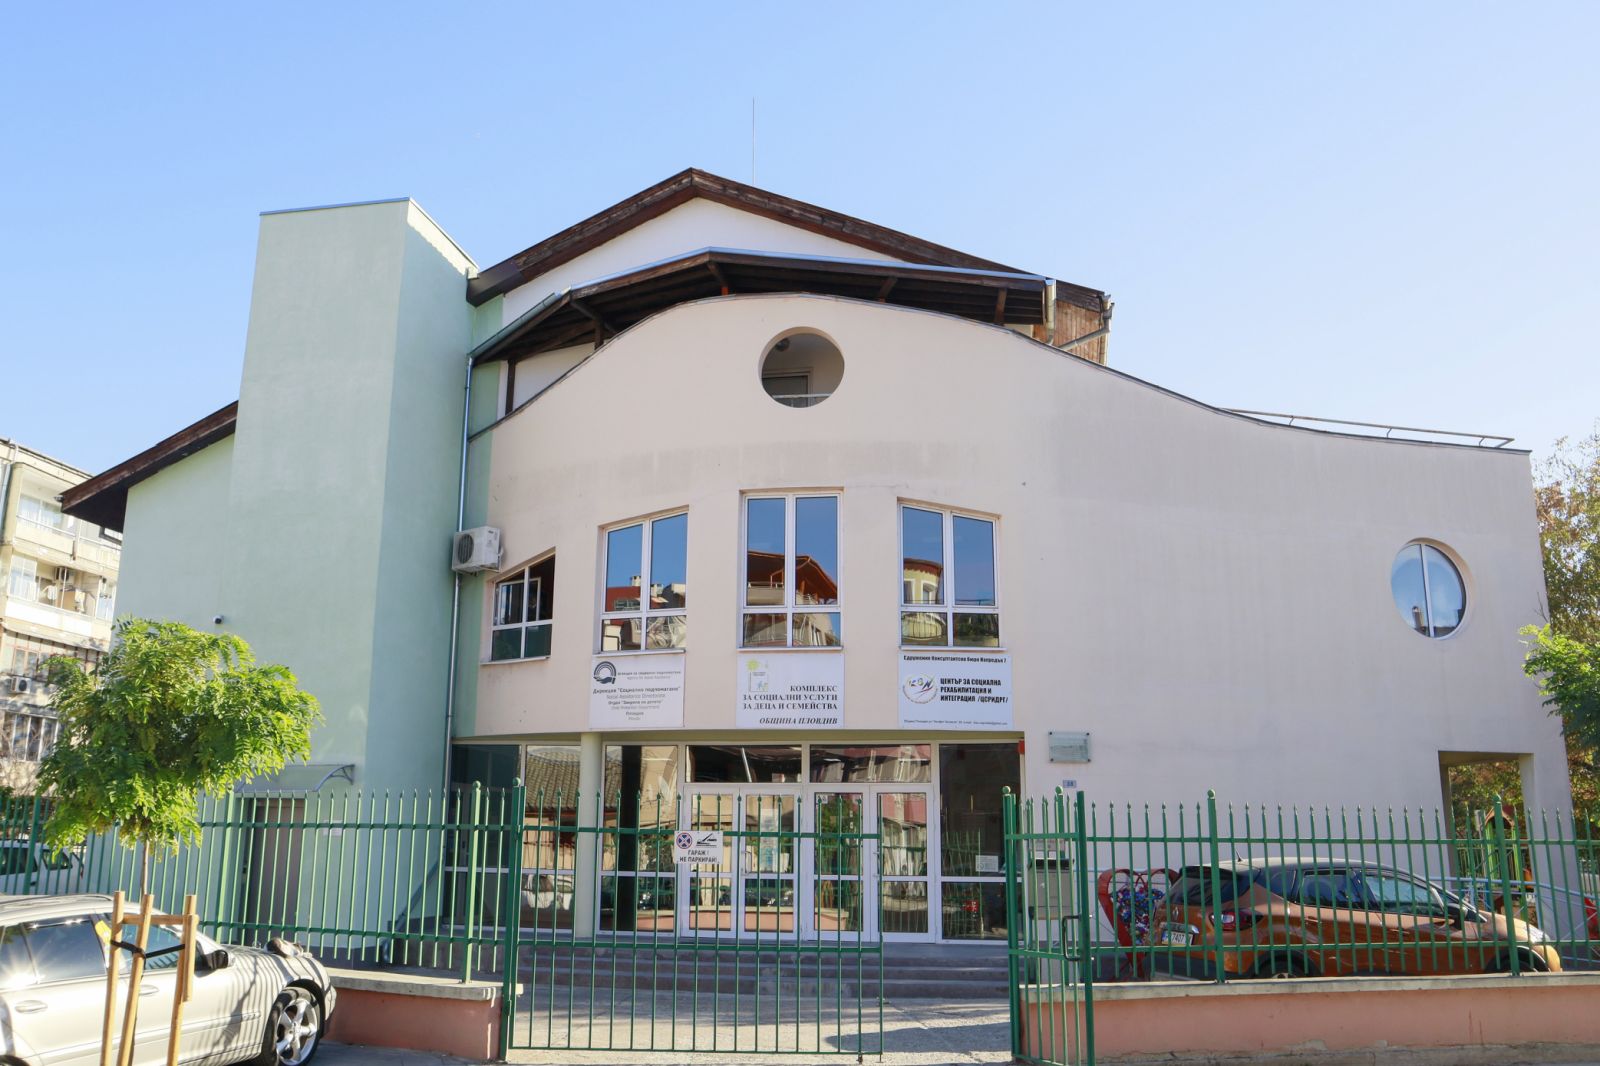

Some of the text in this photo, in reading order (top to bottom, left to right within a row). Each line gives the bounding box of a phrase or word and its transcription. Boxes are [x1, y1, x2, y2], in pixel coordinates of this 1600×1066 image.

[754, 694, 801, 702] СОЦИАЛНИ
[760, 717, 838, 725] ОБЩИНА ПЛОВДИВ
